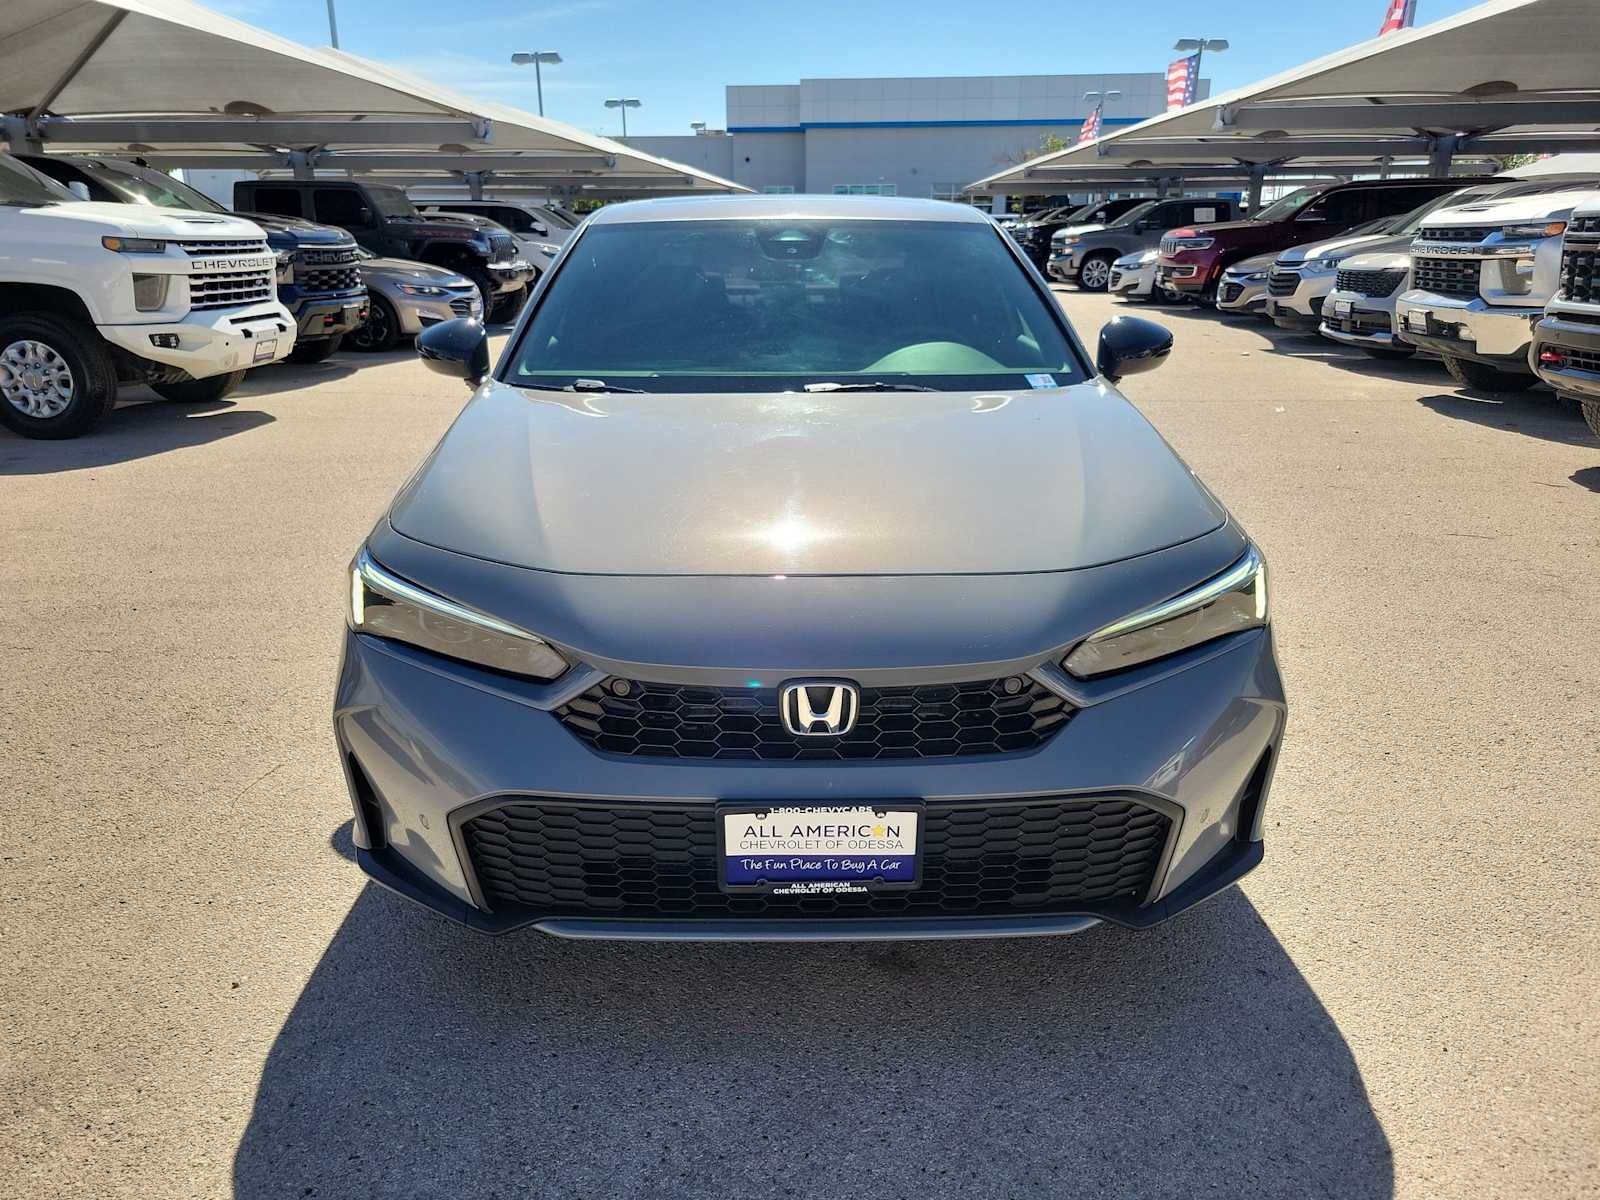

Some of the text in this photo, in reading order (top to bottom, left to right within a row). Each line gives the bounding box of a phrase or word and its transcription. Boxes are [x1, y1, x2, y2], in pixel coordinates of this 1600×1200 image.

[191, 257, 273, 270] CHEVROLET
[769, 806, 873, 814] 1-800-CHEVYCARS
[743, 825, 783, 838] ALL
[740, 840, 904, 849] CHEVROLET OF ODESSA
[740, 858, 902, 874] The Fun Place To Buy A Car
